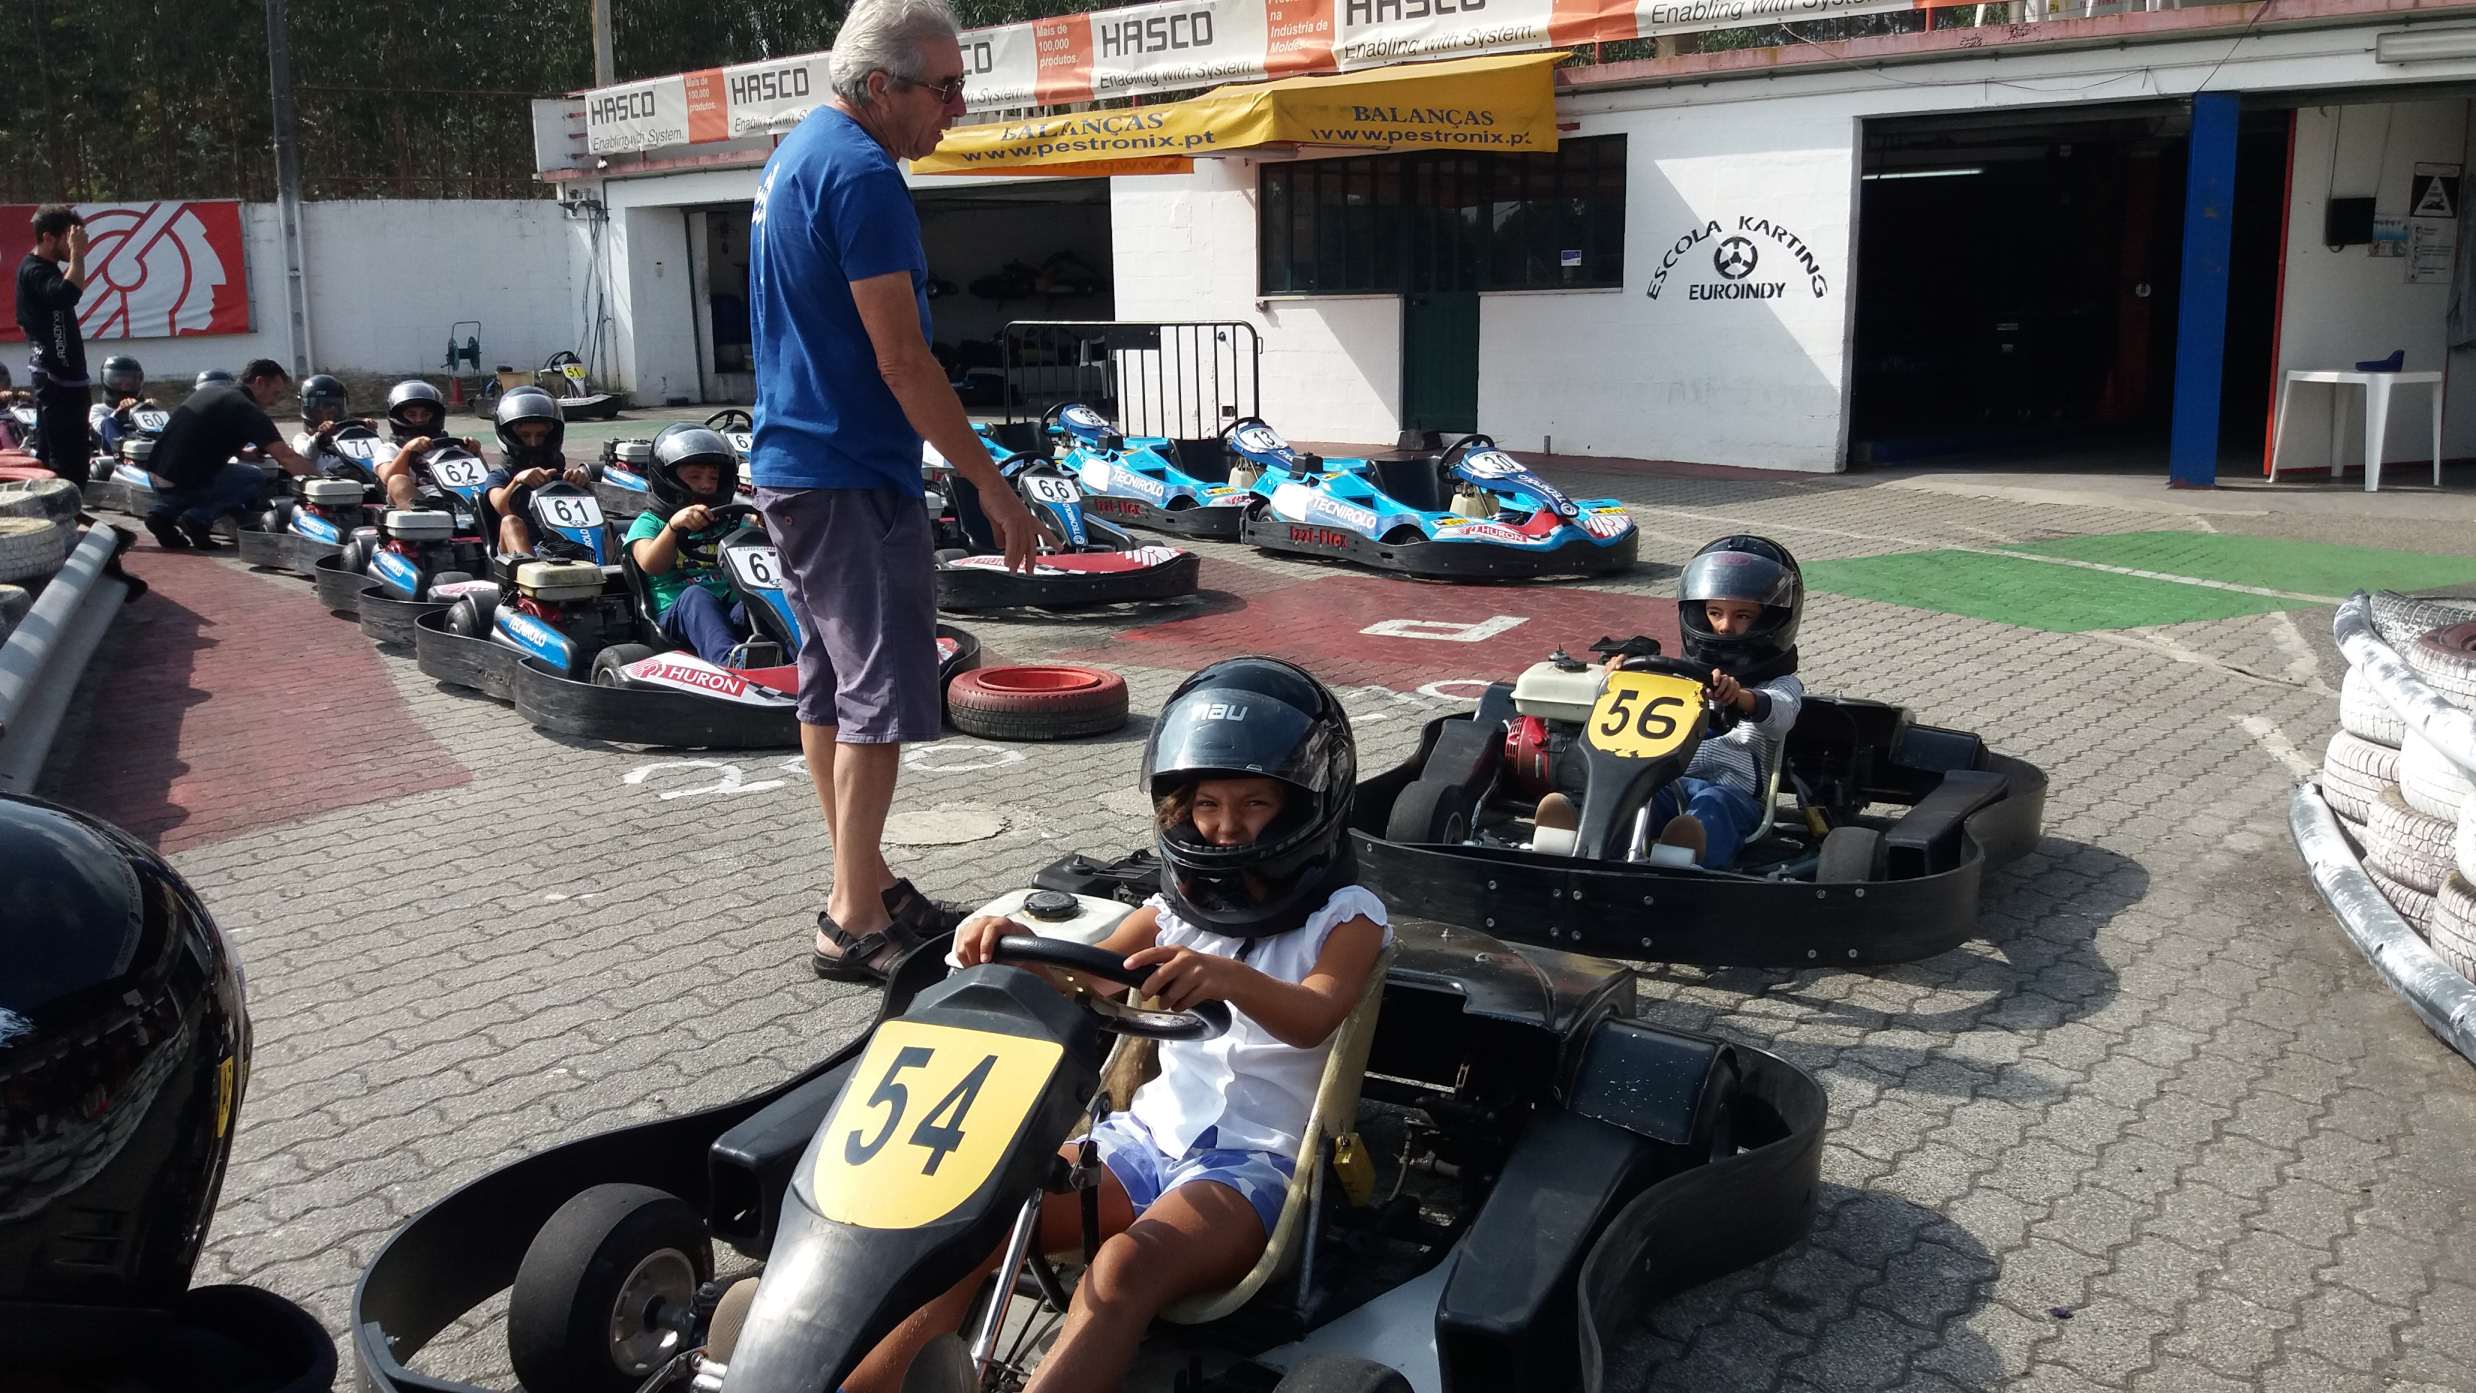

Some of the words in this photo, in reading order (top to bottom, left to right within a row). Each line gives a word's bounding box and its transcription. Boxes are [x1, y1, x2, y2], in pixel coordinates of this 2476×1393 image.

[1270, 11, 1282, 21] na
[1347, 0, 1486, 26] HAS
[1652, 0, 1743, 24] Enabling
[1036, 25, 1055, 37] Mais
[1057, 24, 1068, 34] de
[1102, 10, 1213, 58] HASCO
[1270, 22, 1313, 38] Indústria
[1315, 20, 1328, 32] de
[1345, 37, 1420, 60] Enabling
[1424, 32, 1458, 50] with
[1463, 24, 1537, 48] System.
[1039, 54, 1080, 69] produtos.
[686, 78, 700, 87] Mais
[732, 68, 810, 105] HASCO
[1100, 70, 1159, 89] Enabling
[1162, 65, 1191, 81] with
[591, 91, 656, 126] HASCO
[1353, 105, 1494, 129] BALANÇAS
[647, 127, 684, 147] System.
[962, 130, 1216, 162] www.pestronix.pt
[1646, 220, 1722, 300] ESCOLA
[1739, 216, 1828, 298] KARTING
[1689, 282, 1786, 300] EUROINDY
[567, 367, 581, 378] 51
[142, 413, 164, 427] 60
[348, 439, 375, 458] 71
[1253, 431, 1276, 448] 13
[445, 461, 479, 482] 62
[1484, 454, 1516, 471] 30
[1038, 479, 1070, 499] 66
[1112, 470, 1165, 497] TECNIROLO
[554, 500, 589, 522] 61
[1312, 497, 1377, 529] TECNIROLO
[669, 665, 741, 695] HURON
[1600, 689, 1684, 740] 56
[844, 1046, 999, 1177] 54
